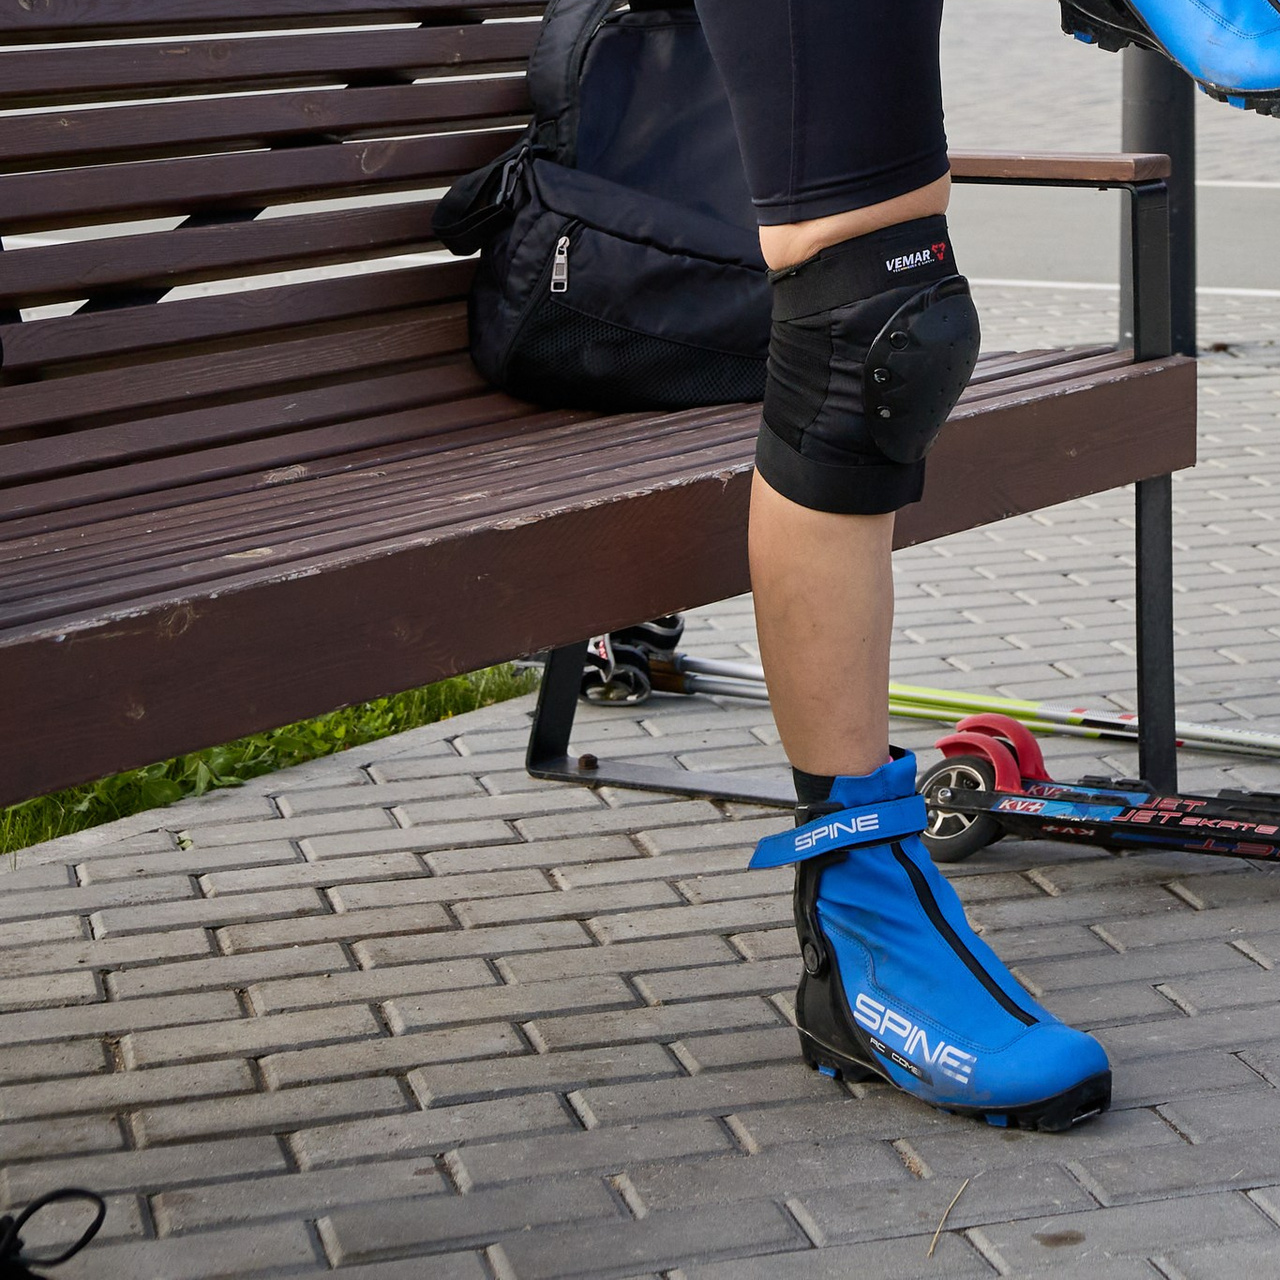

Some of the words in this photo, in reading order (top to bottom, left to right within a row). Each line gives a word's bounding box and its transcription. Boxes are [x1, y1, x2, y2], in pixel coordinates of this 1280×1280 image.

[885, 249, 931, 271] VEMAR
[998, 799, 1042, 813] KV+
[1138, 796, 1208, 813] JET
[795, 813, 880, 851] SPINE
[1111, 809, 1183, 825] JET
[1179, 816, 1280, 836] SKATE
[853, 992, 977, 1085] SPINE
